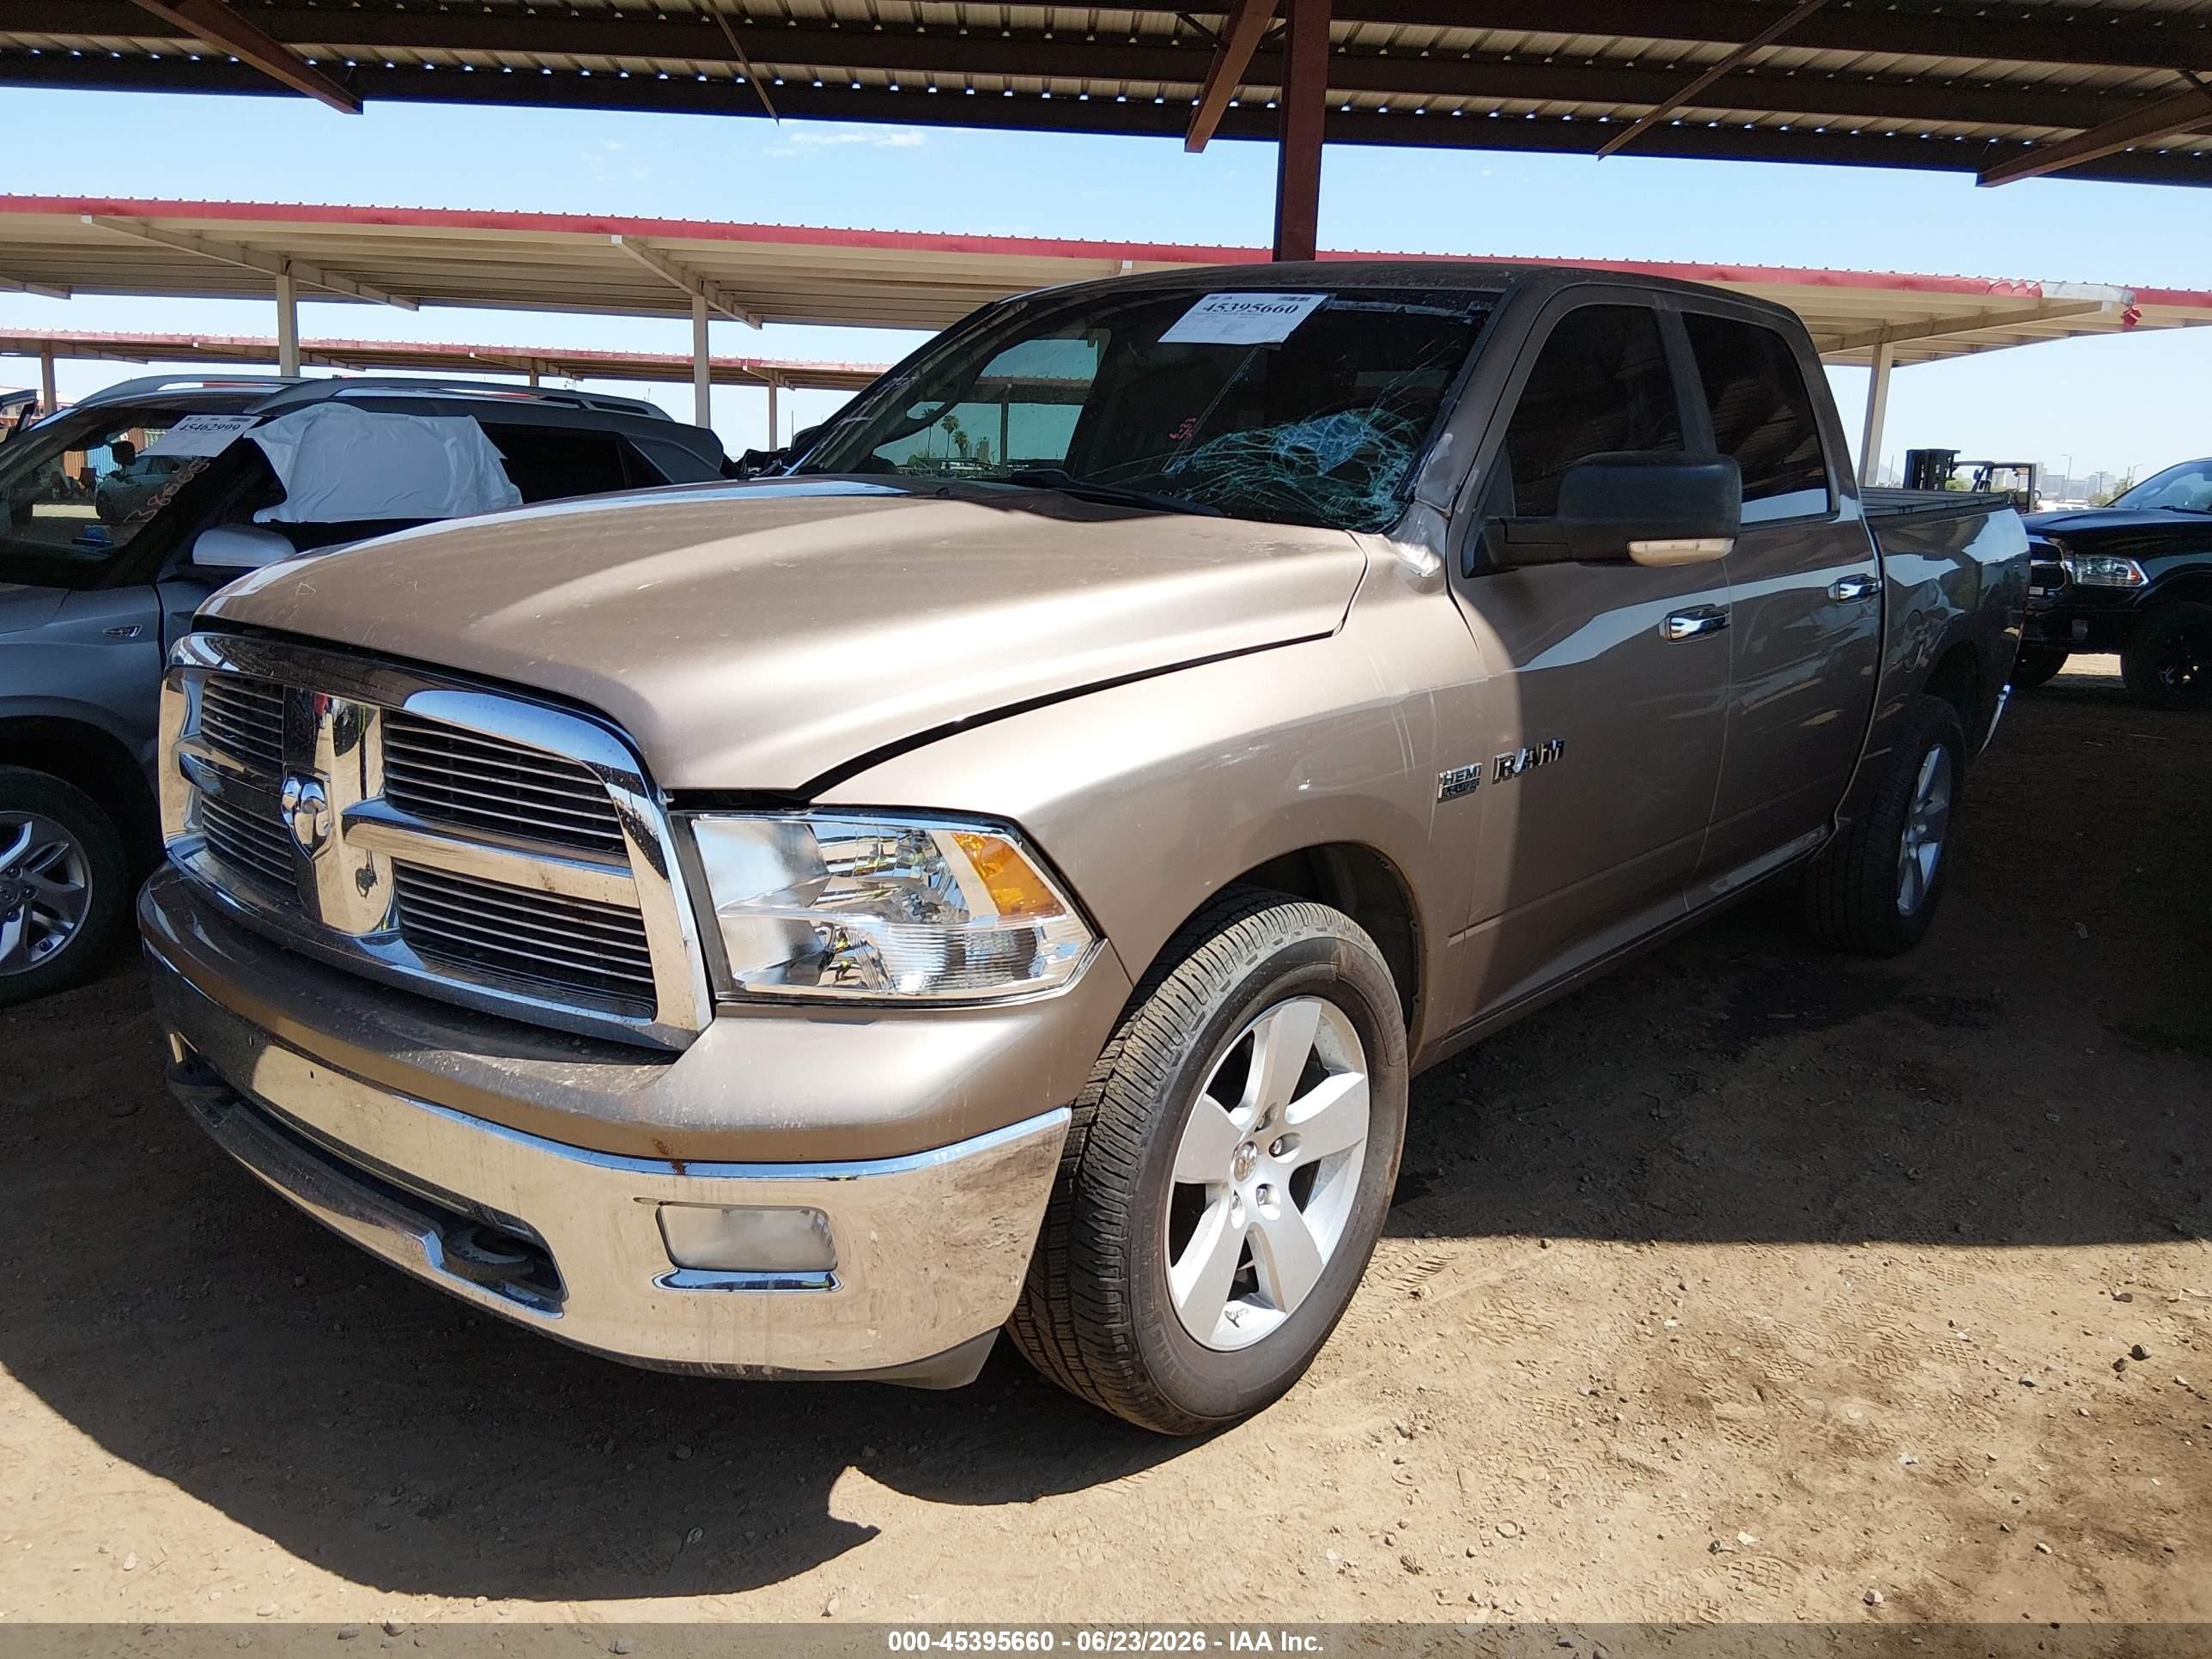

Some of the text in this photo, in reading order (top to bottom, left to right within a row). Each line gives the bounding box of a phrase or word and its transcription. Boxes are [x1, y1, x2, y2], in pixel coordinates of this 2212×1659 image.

[1202, 302, 1299, 314] 45395660
[1492, 738, 1565, 785] RAM
[1437, 763, 1483, 788] HEMI
